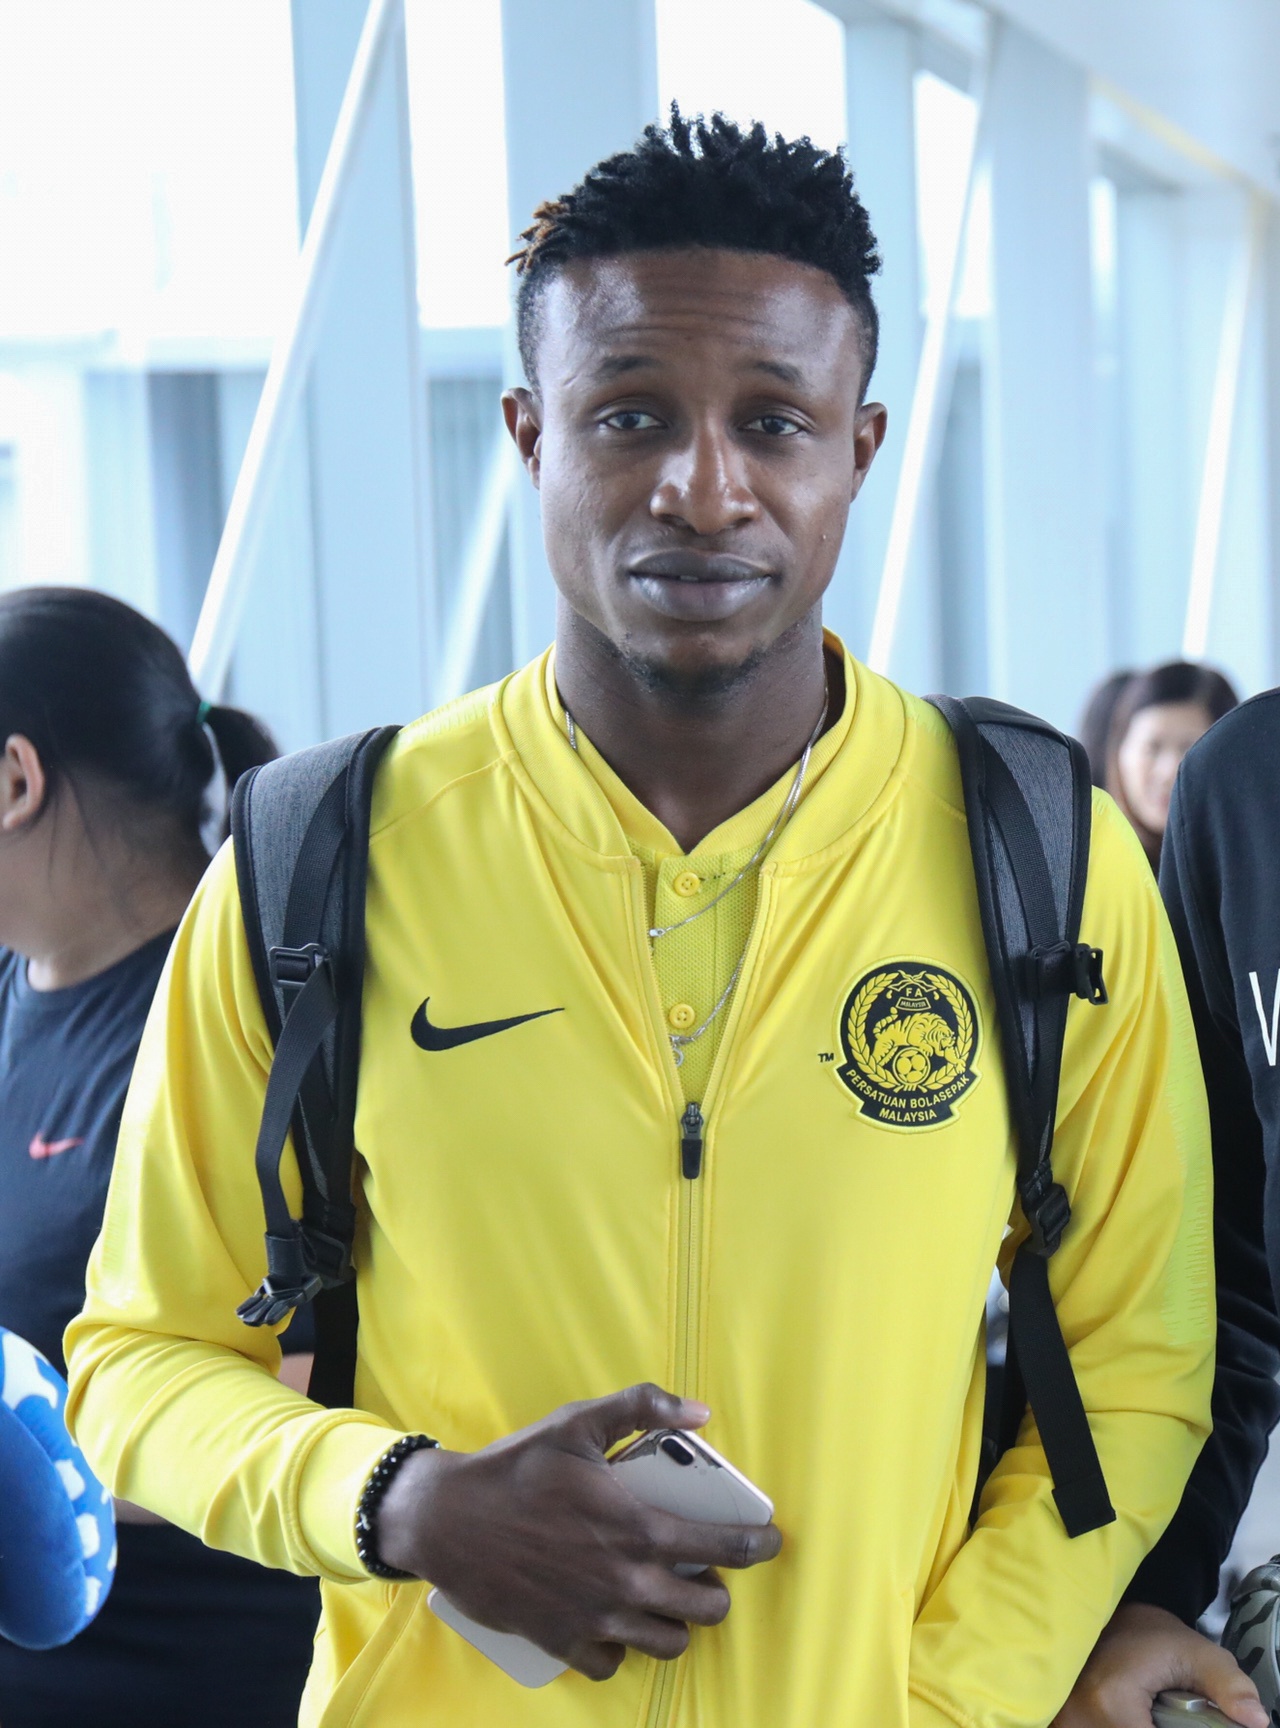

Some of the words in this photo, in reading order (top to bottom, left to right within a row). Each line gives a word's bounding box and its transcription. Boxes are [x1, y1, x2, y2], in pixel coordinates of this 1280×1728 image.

[900, 1000, 926, 1008] MALAYSIA
[846, 1069, 907, 1109] PERSATUAN
[910, 1076, 970, 1109] BOLASEPAK
[879, 1107, 938, 1123] MALAYSIA
